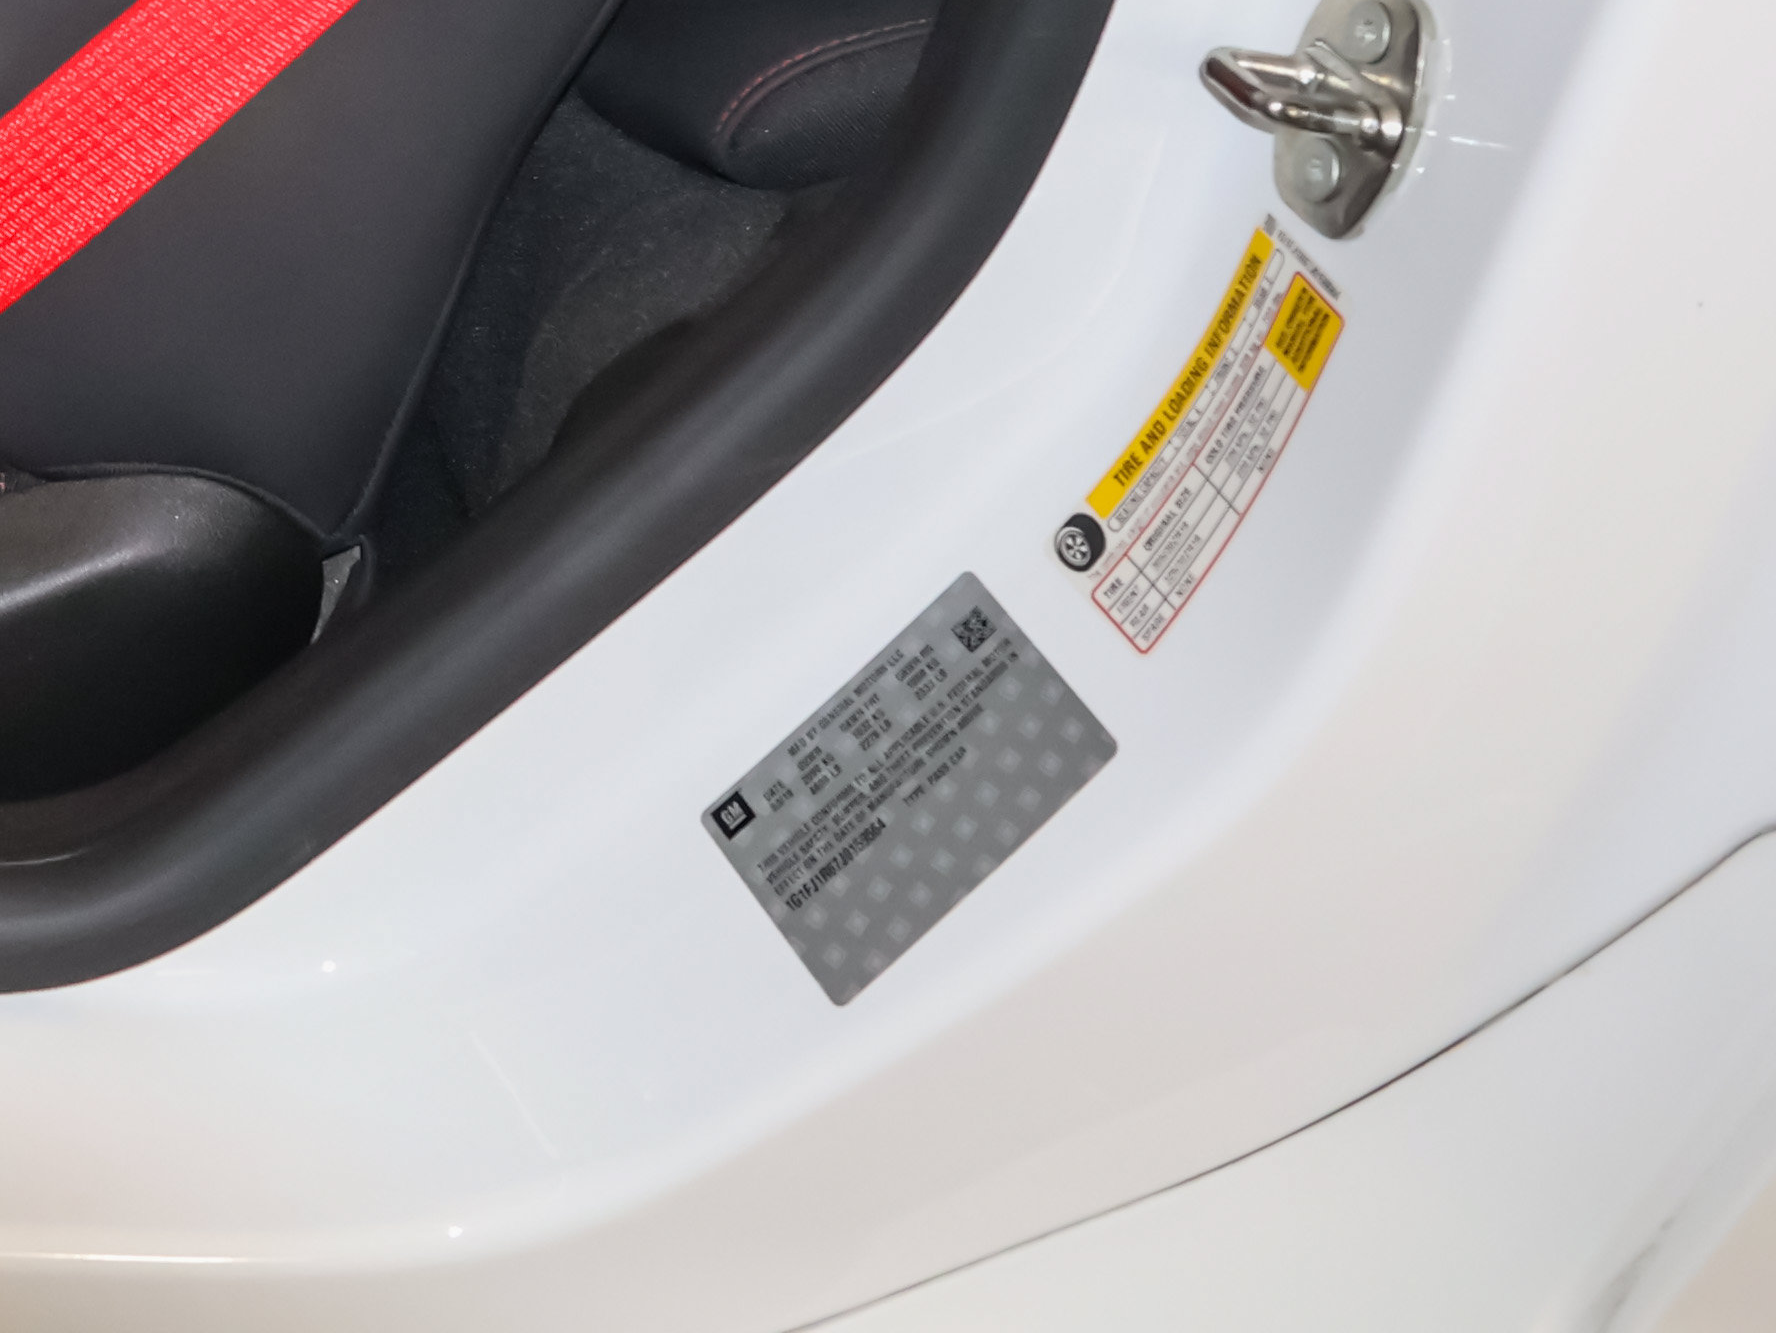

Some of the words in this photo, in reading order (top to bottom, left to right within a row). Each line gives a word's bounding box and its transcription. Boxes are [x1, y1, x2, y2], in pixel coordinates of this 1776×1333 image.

[1112, 452, 1144, 486] TIRE
[1137, 419, 1168, 455] AND
[1160, 356, 1211, 421] LOADING
[1202, 254, 1263, 358] INFORMATION
